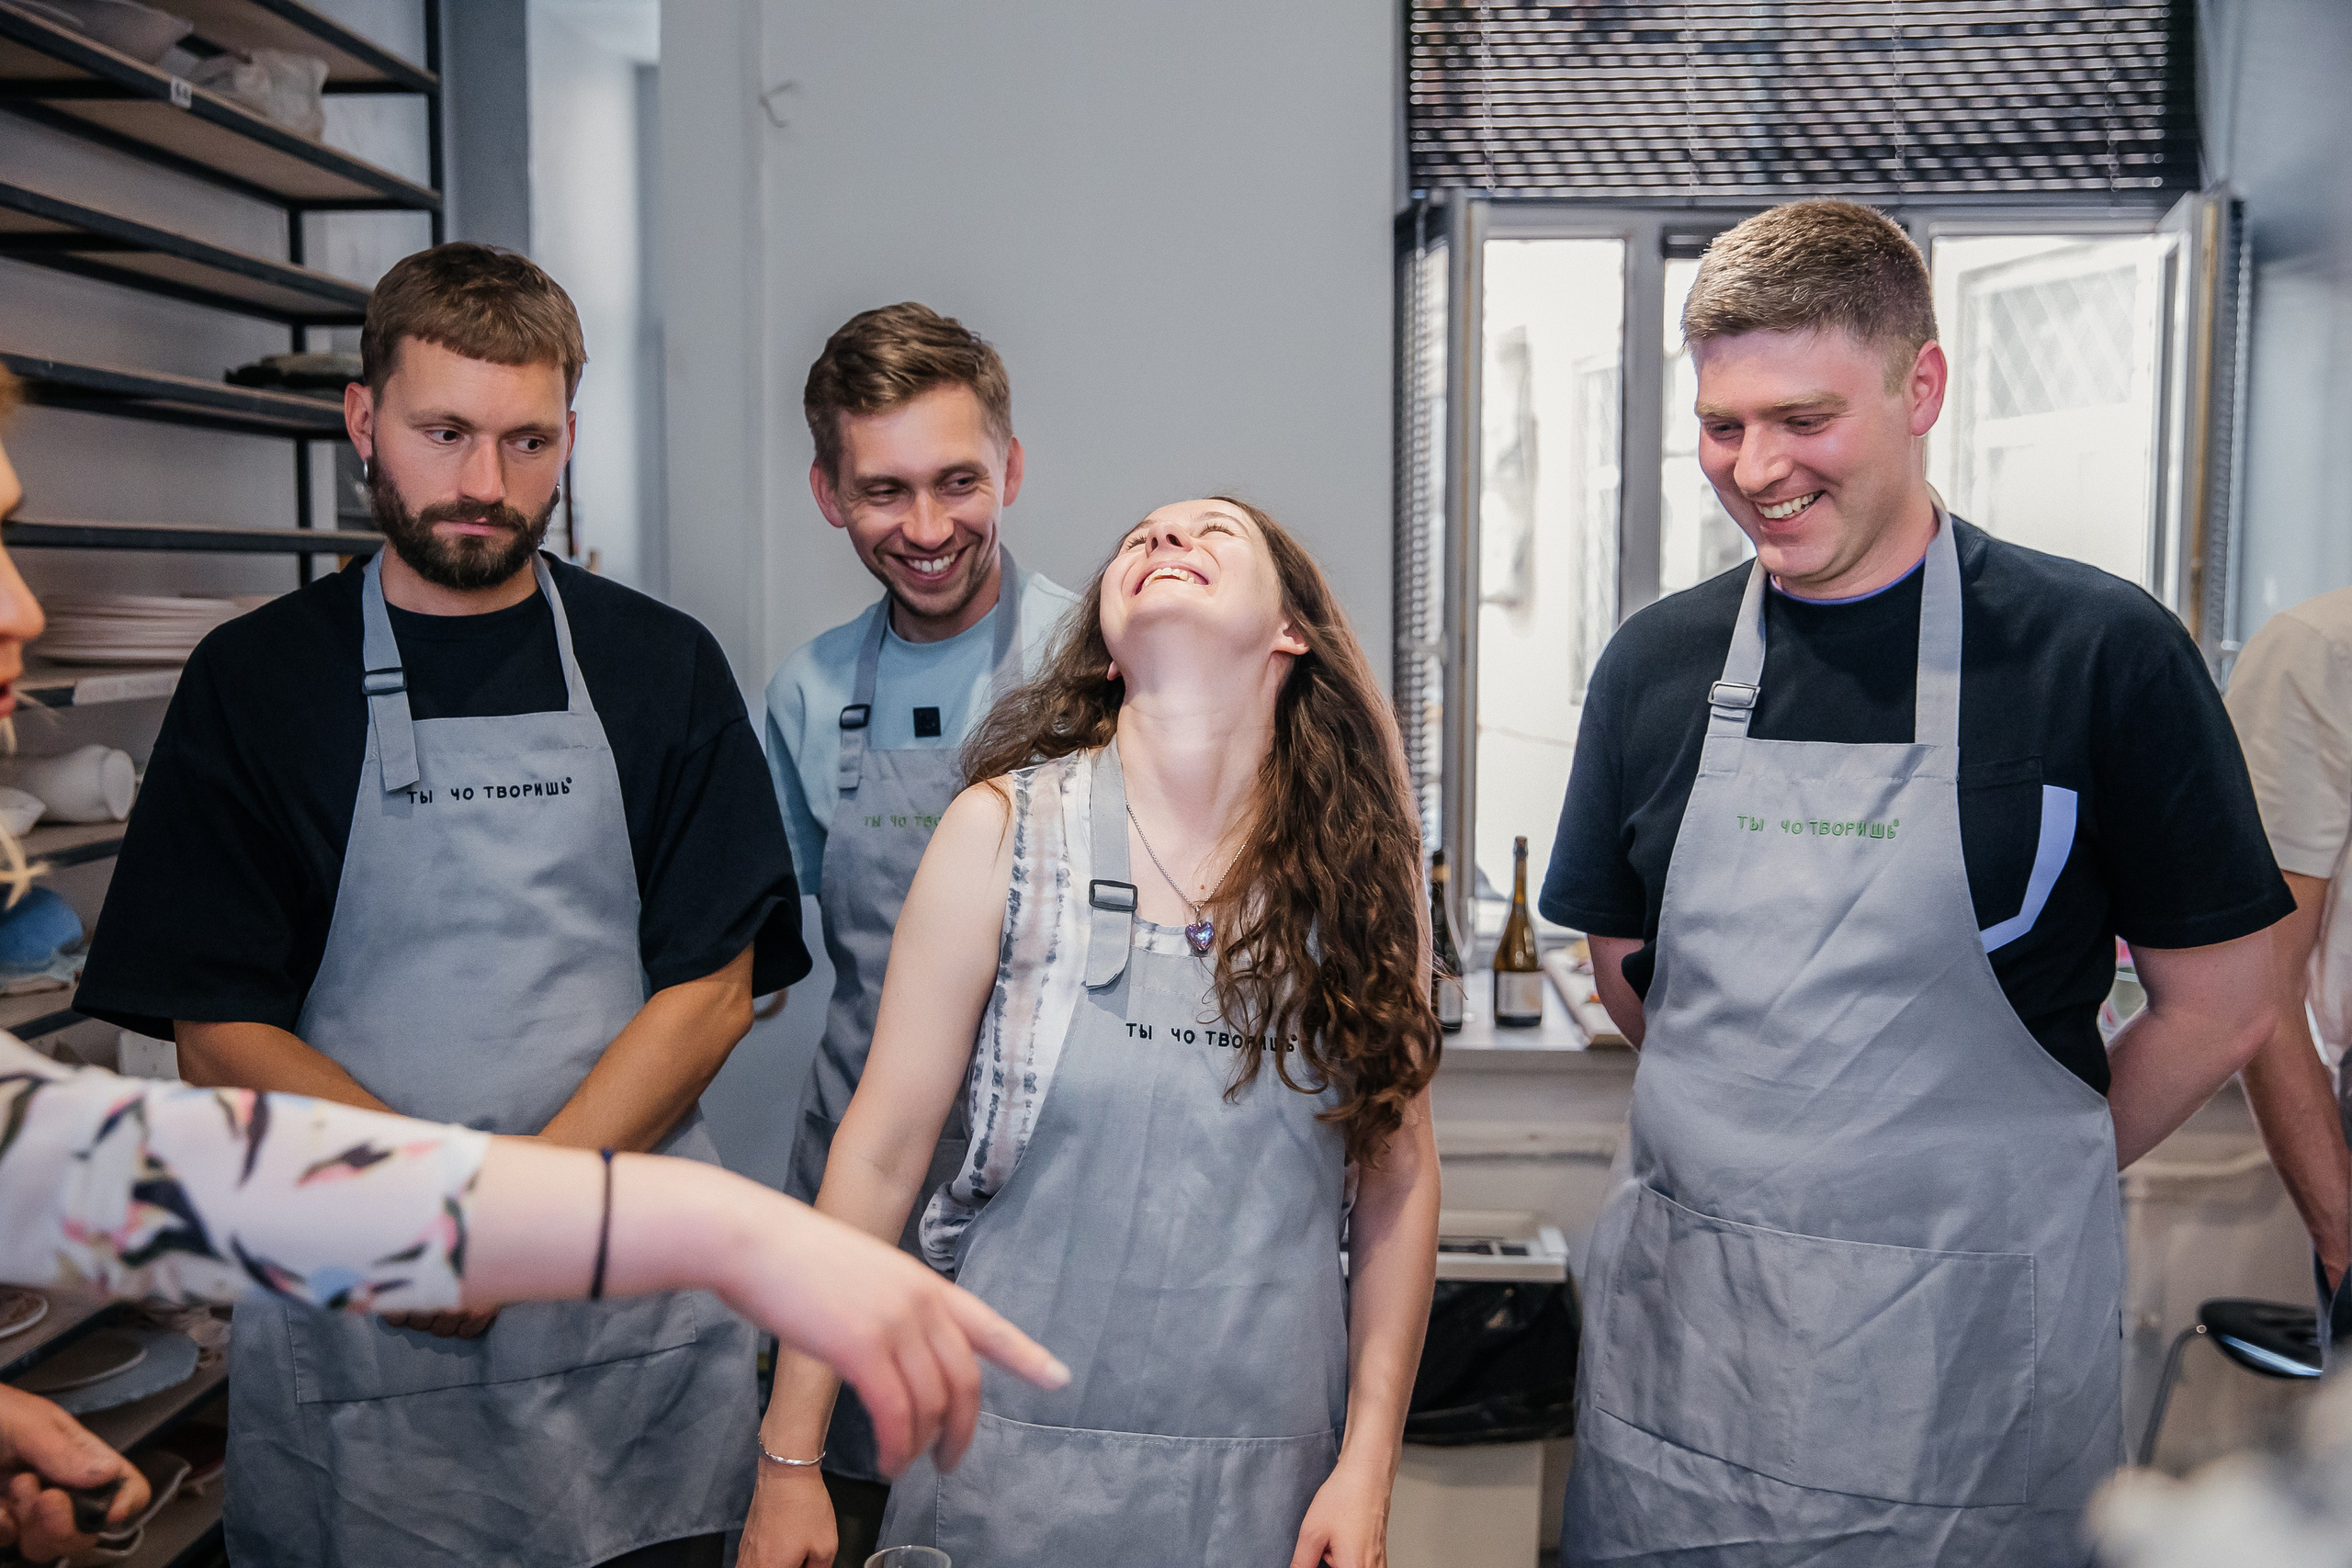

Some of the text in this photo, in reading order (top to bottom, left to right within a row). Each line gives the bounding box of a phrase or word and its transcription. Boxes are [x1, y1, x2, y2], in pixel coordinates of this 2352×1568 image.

[406, 790, 433, 805] ТЫ
[450, 787, 474, 801] ЧО
[1736, 814, 1764, 832] ТЫ
[1781, 819, 1804, 835] ЧО
[1125, 1022, 1152, 1040] ТЫ
[1170, 1027, 1195, 1045] ЧО
